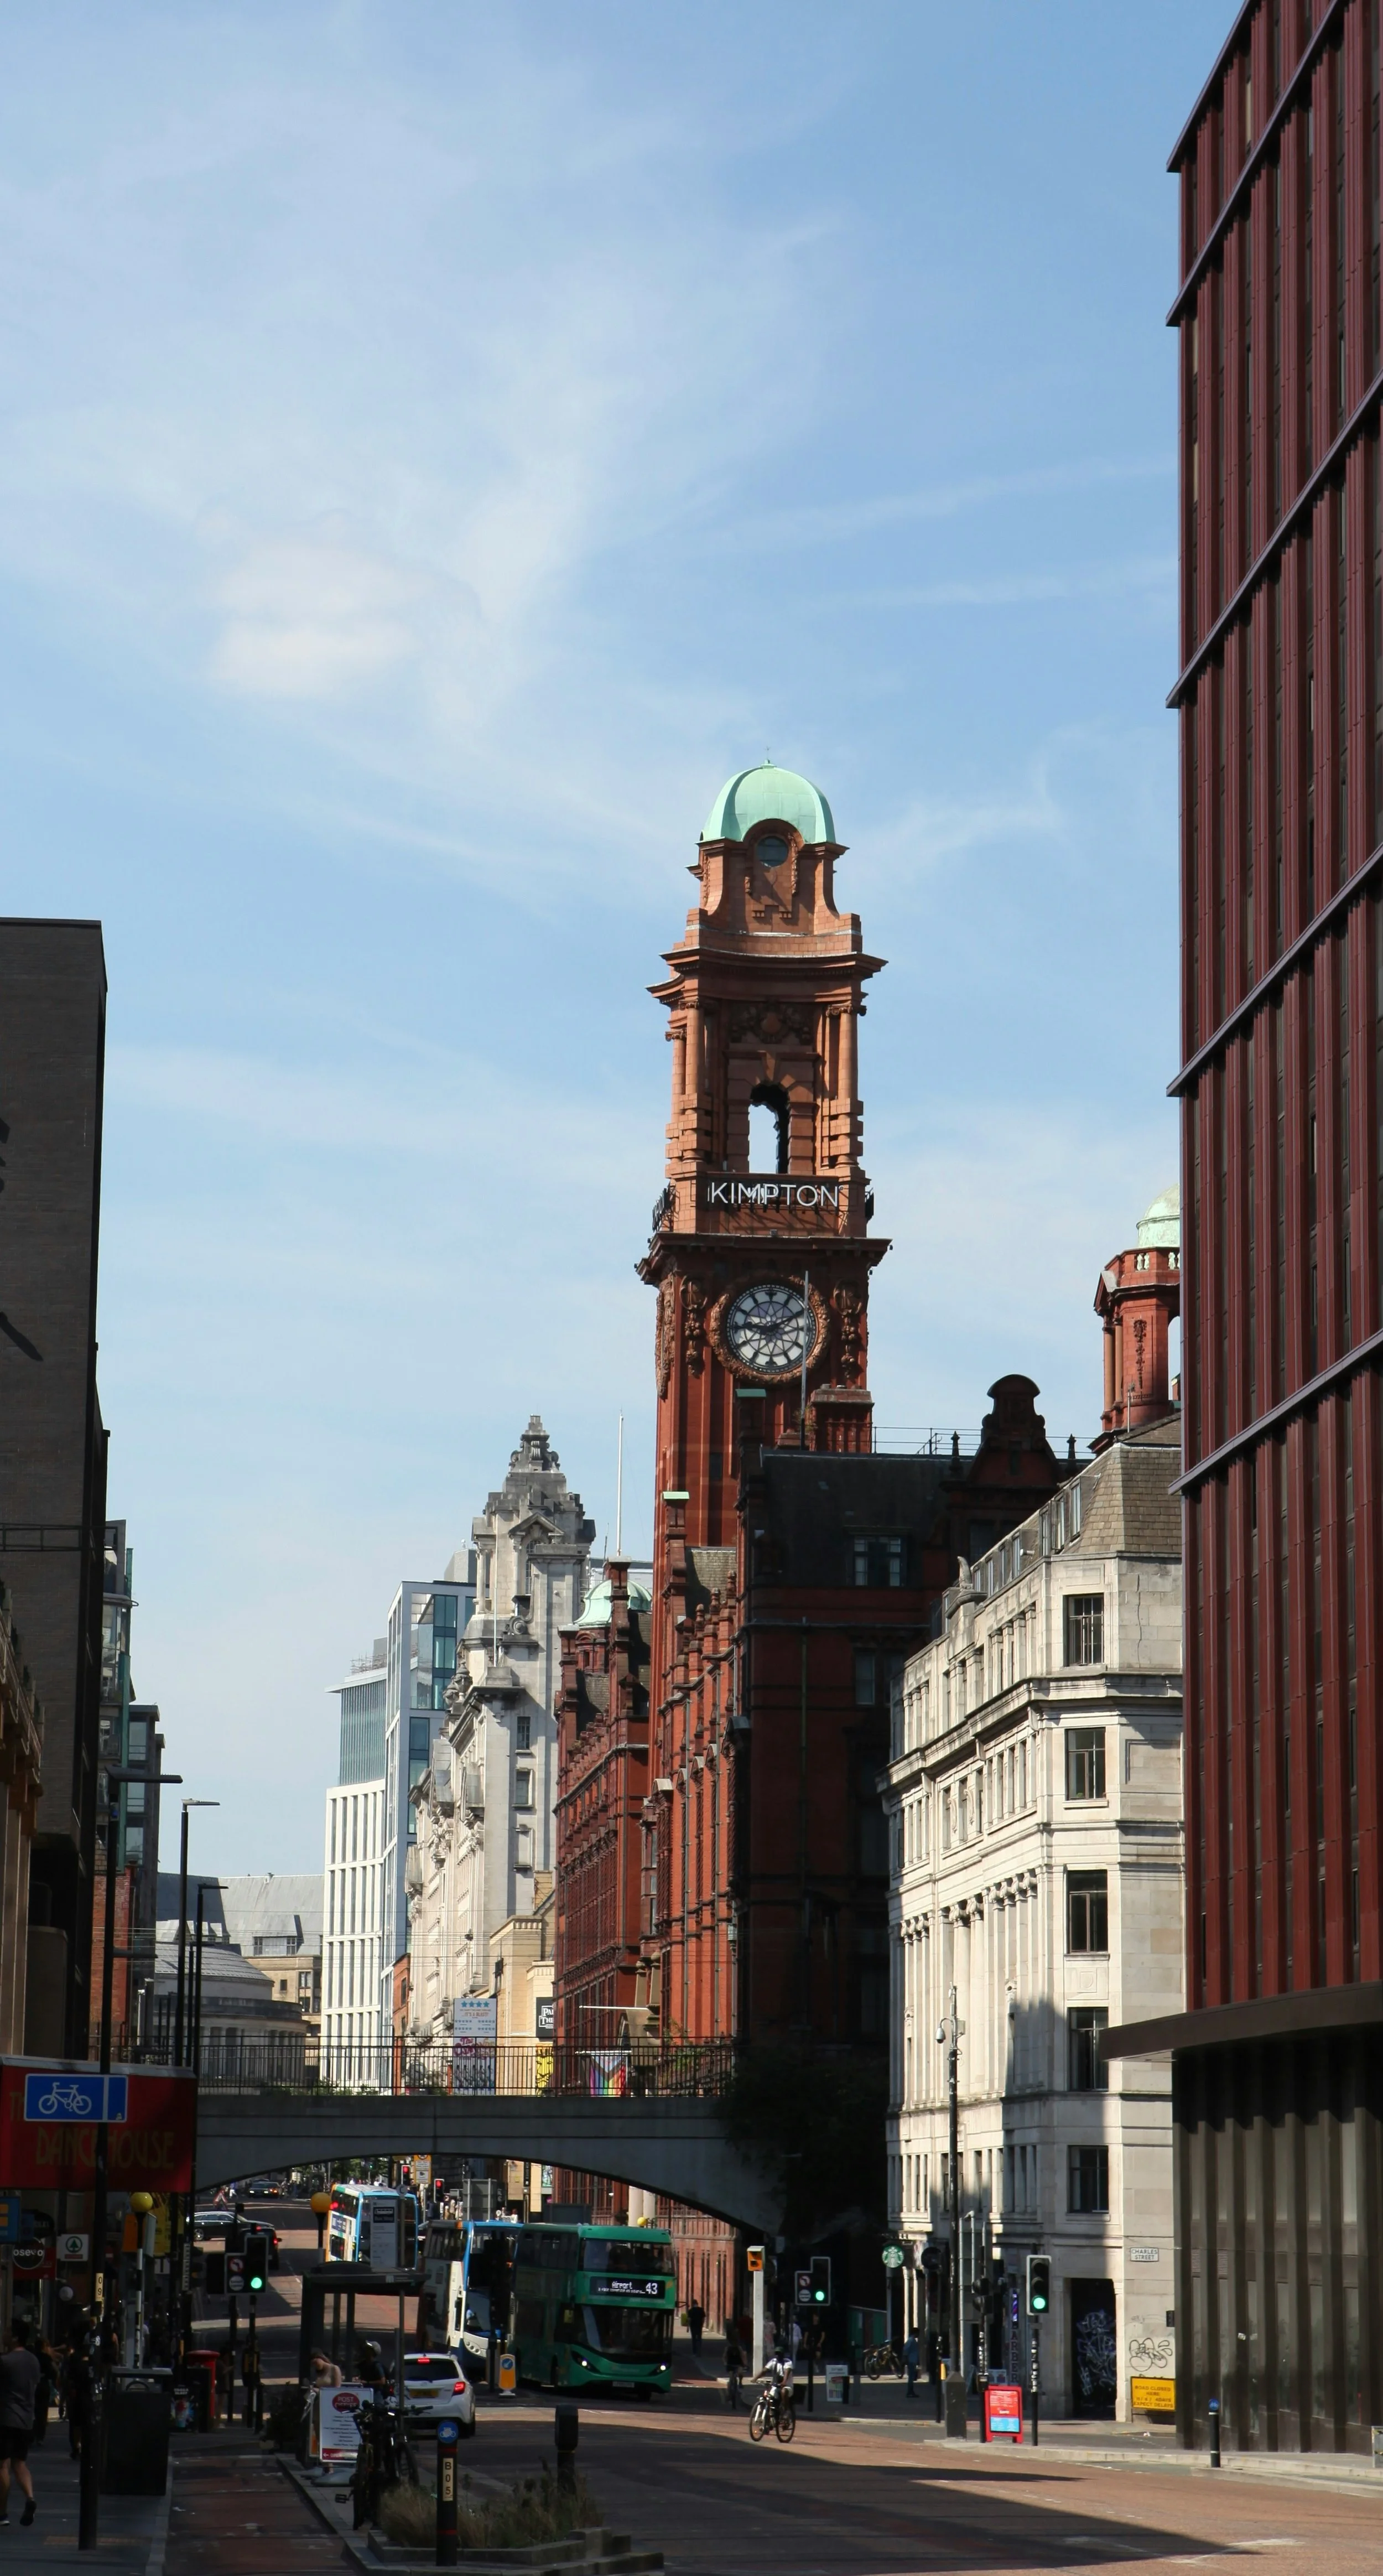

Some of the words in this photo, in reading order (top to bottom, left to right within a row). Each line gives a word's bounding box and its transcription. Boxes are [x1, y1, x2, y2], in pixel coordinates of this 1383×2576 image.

[710, 1182, 839, 1207] KIMPTON
[612, 2281, 632, 2289] Airport
[646, 2282, 658, 2294] 43
